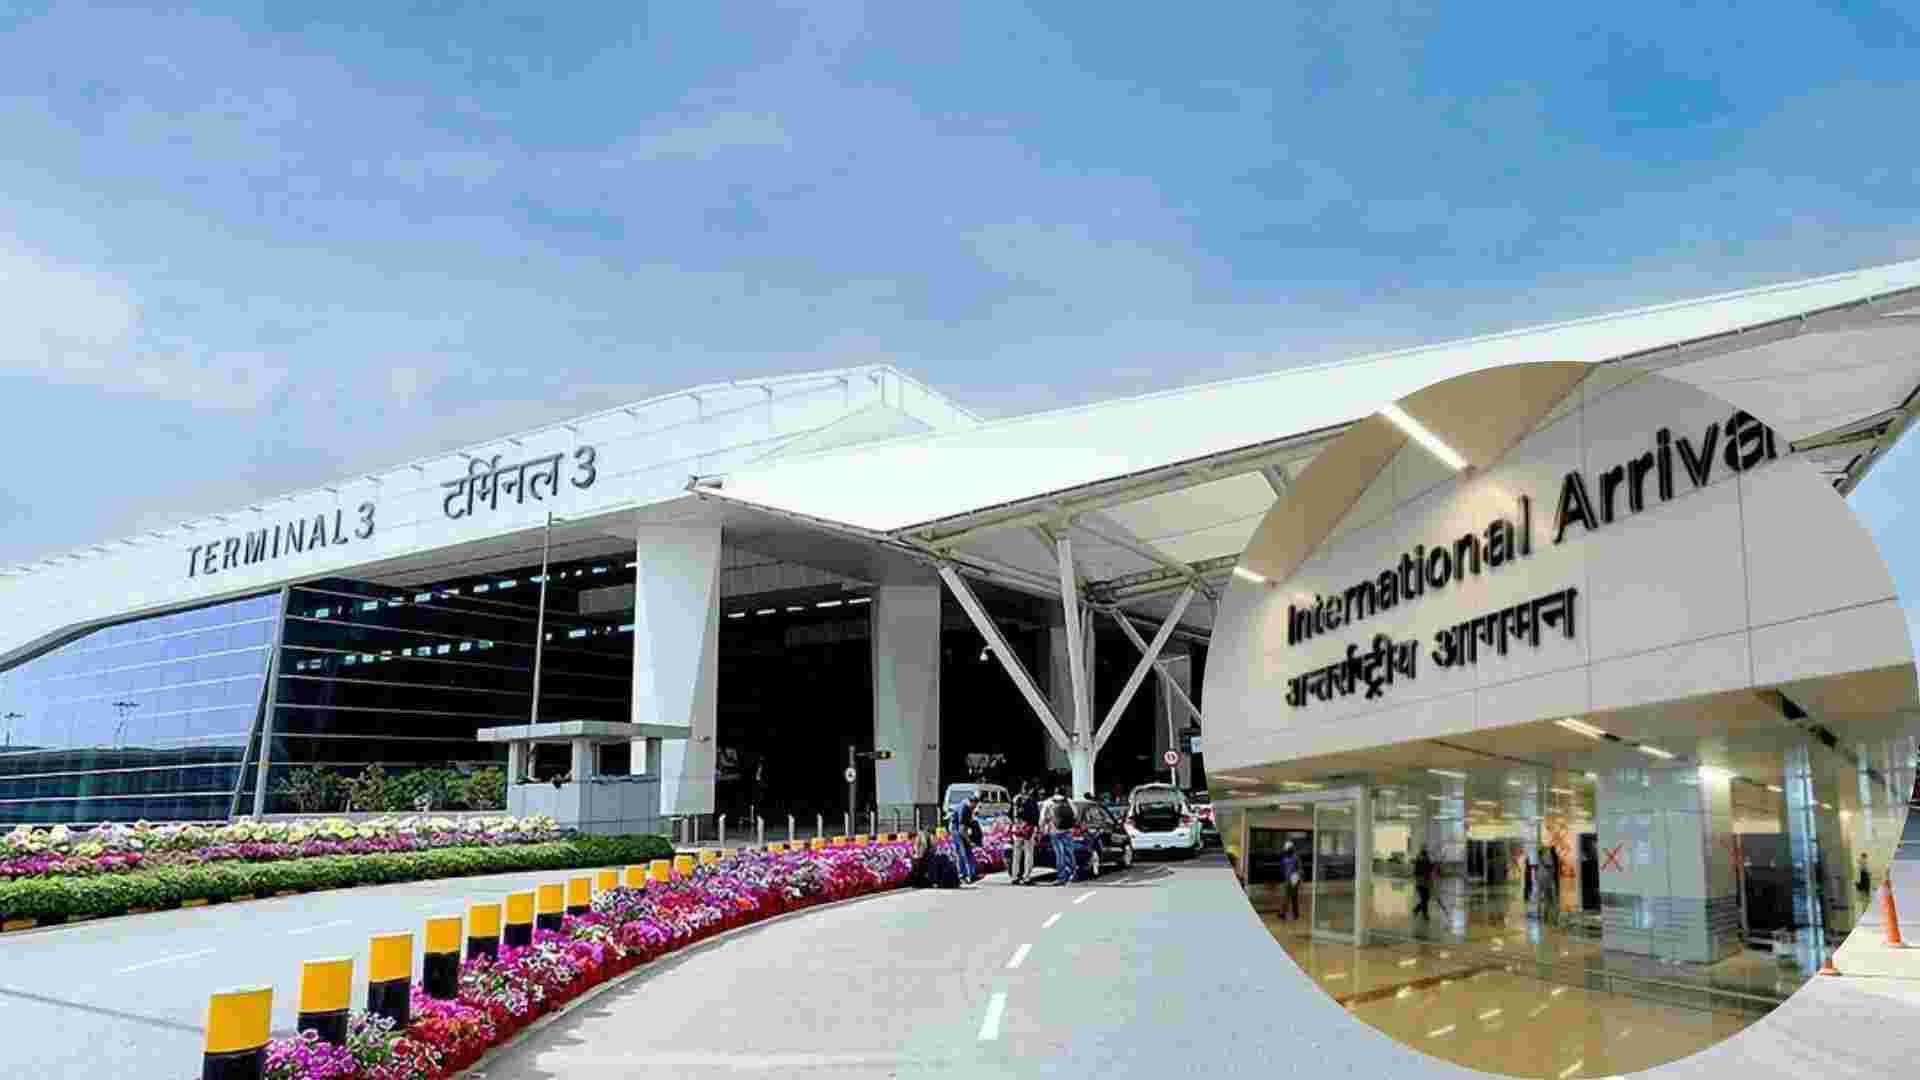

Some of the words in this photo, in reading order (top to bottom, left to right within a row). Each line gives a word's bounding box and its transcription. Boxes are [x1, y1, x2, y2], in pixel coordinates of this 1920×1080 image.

[440, 452, 564, 519] टर्मिनल
[571, 446, 597, 489] 3
[185, 508, 350, 578] TERMINAL
[354, 502, 377, 540] 3
[1286, 496, 1532, 646] International
[1553, 410, 1796, 545] Arriva
[1431, 588, 1578, 668] आगमन
